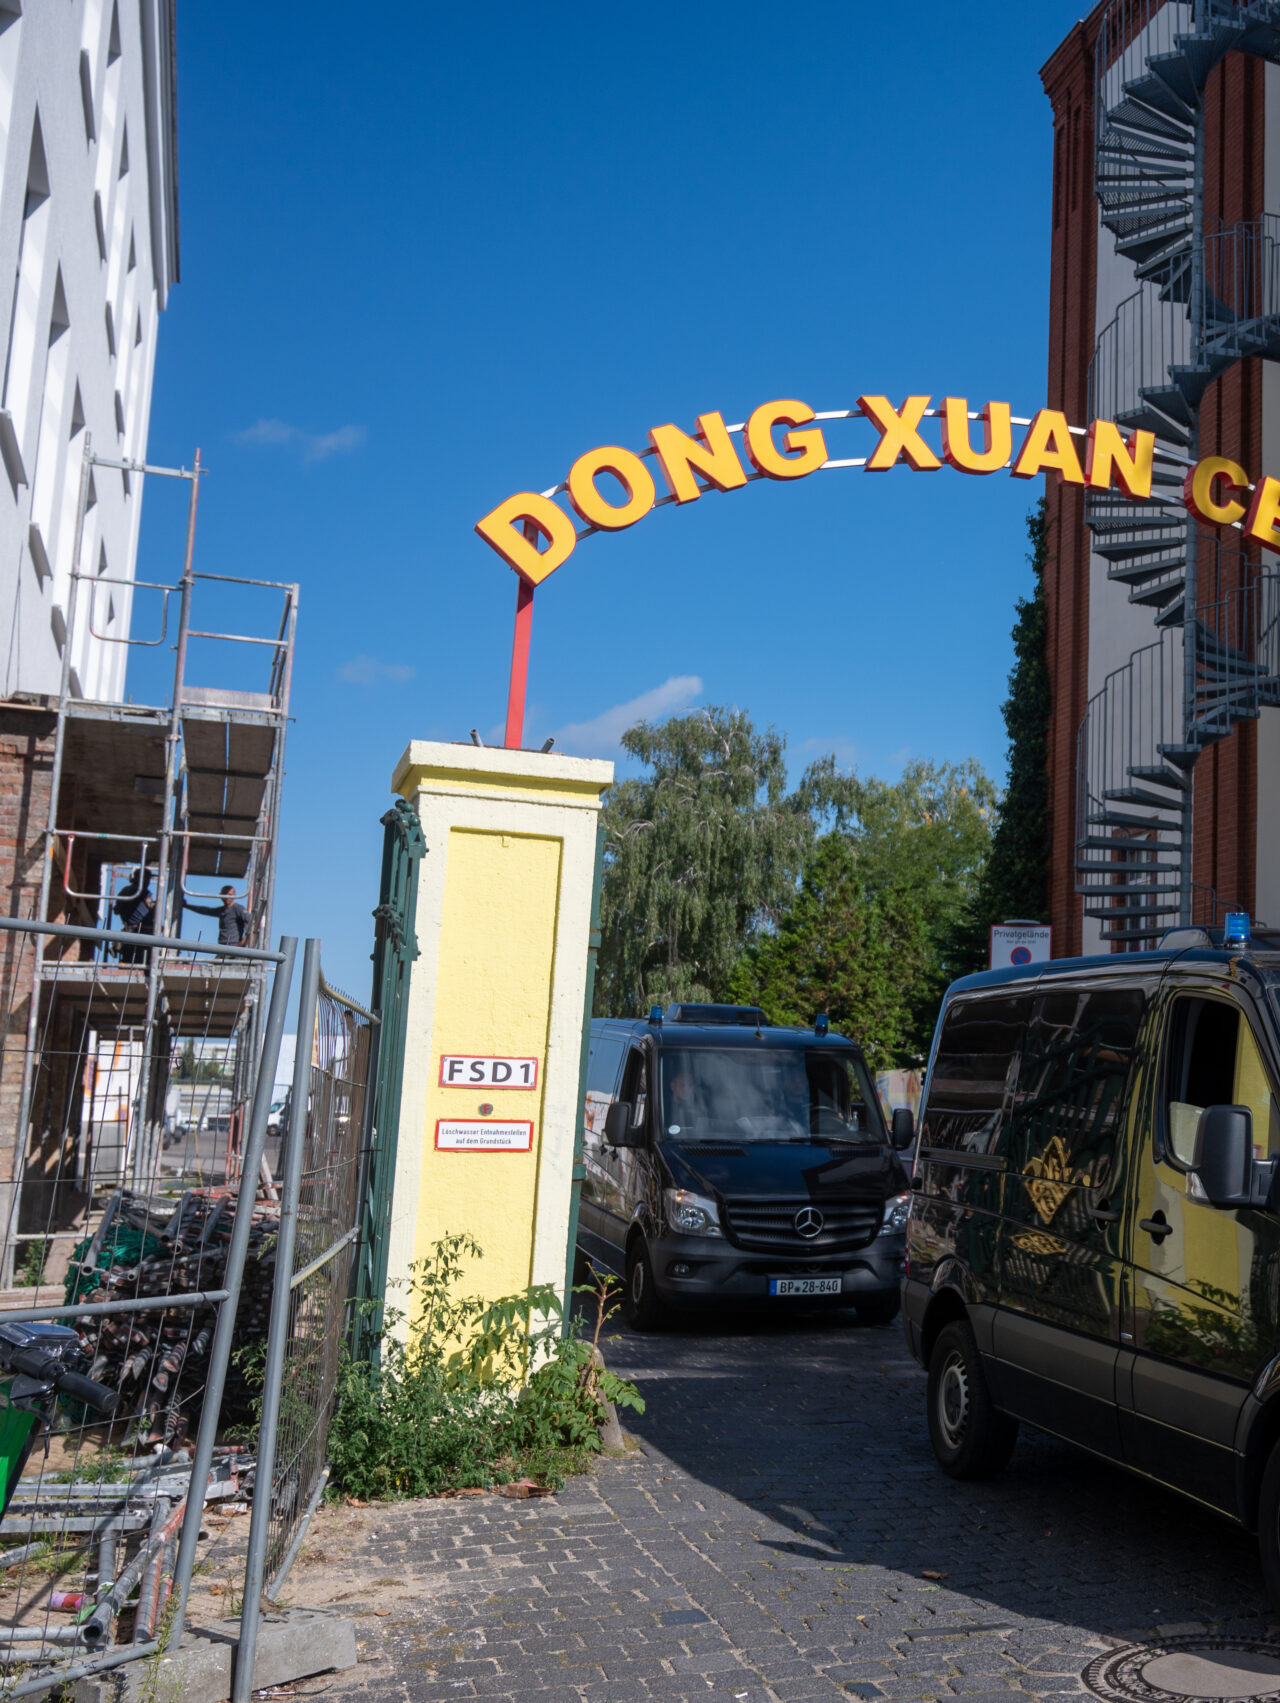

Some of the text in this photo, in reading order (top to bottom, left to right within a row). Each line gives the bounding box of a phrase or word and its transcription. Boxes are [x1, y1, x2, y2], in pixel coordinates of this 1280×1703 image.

[474, 398, 829, 588] DONG
[856, 394, 1156, 501] XUAN
[993, 929, 1050, 940] Privatgelände
[455, 1137, 466, 1145] auf
[466, 1137, 479, 1145] dem
[780, 1280, 838, 1293] BP 28-840
